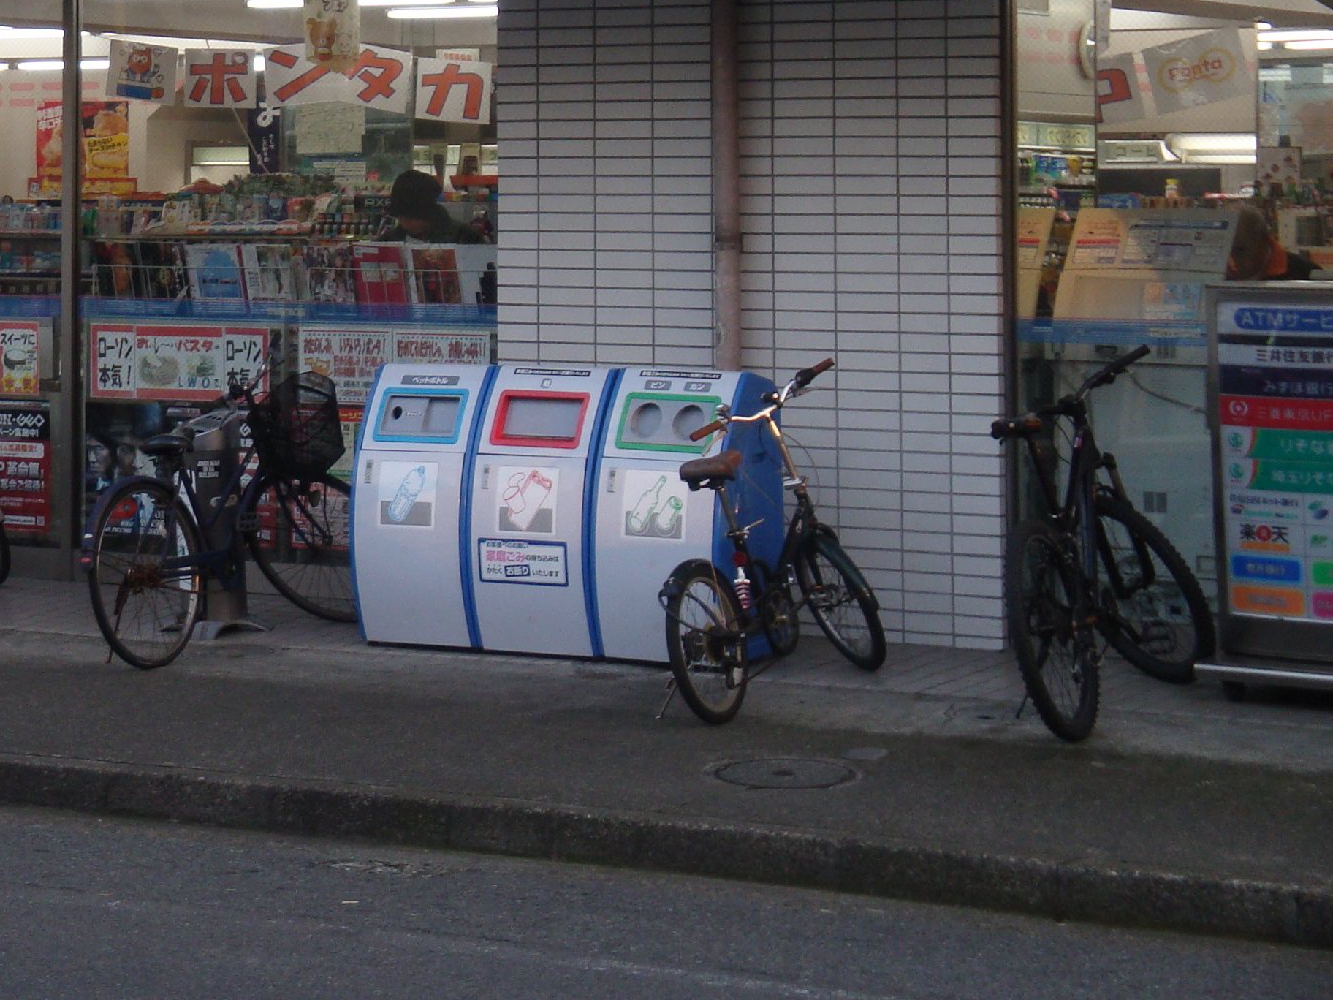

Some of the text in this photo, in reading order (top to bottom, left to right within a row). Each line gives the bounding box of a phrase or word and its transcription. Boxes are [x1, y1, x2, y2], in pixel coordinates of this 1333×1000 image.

[98, 336, 133, 359] ローソン
[226, 339, 262, 363] ローソン
[411, 376, 449, 385] ペットボトル
